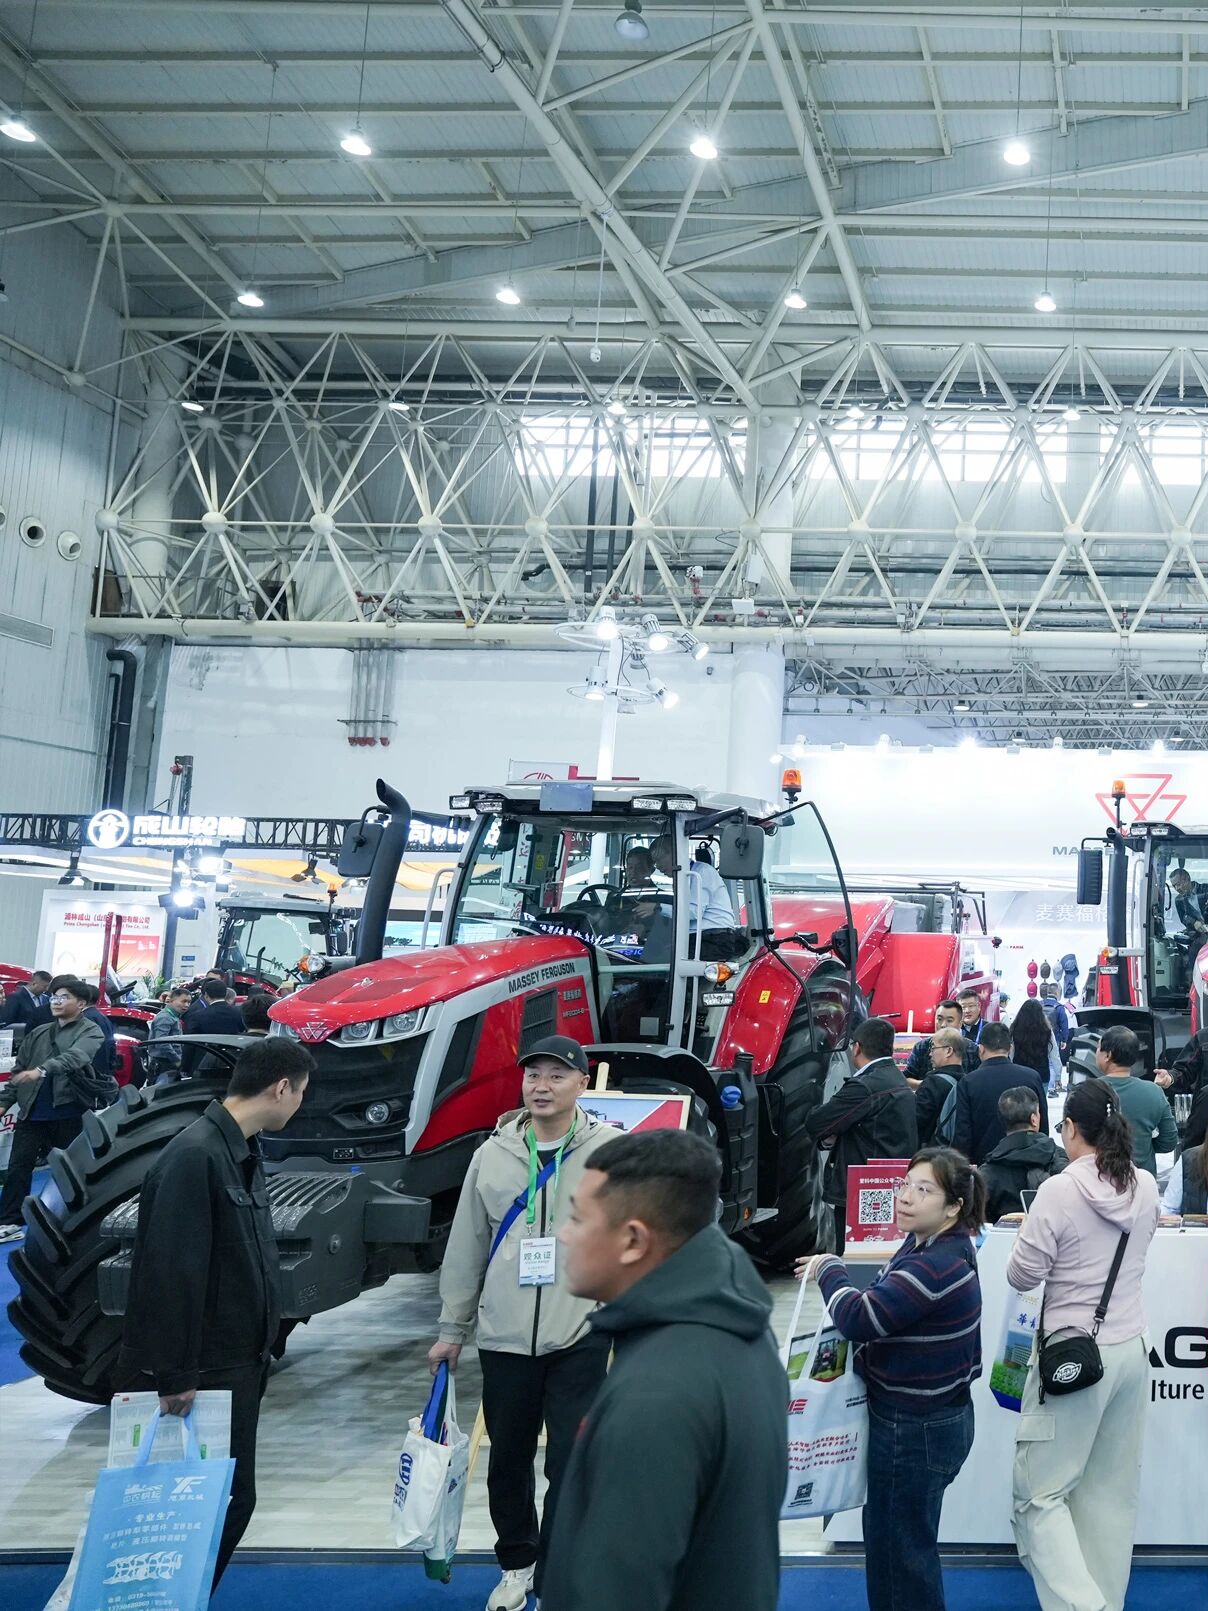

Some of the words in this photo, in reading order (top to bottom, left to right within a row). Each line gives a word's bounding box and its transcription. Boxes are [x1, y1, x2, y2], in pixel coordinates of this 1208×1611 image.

[508, 970, 540, 994] MASSEY
[541, 962, 576, 981] FERGUSON
[1151, 1379, 1205, 1402] lture
